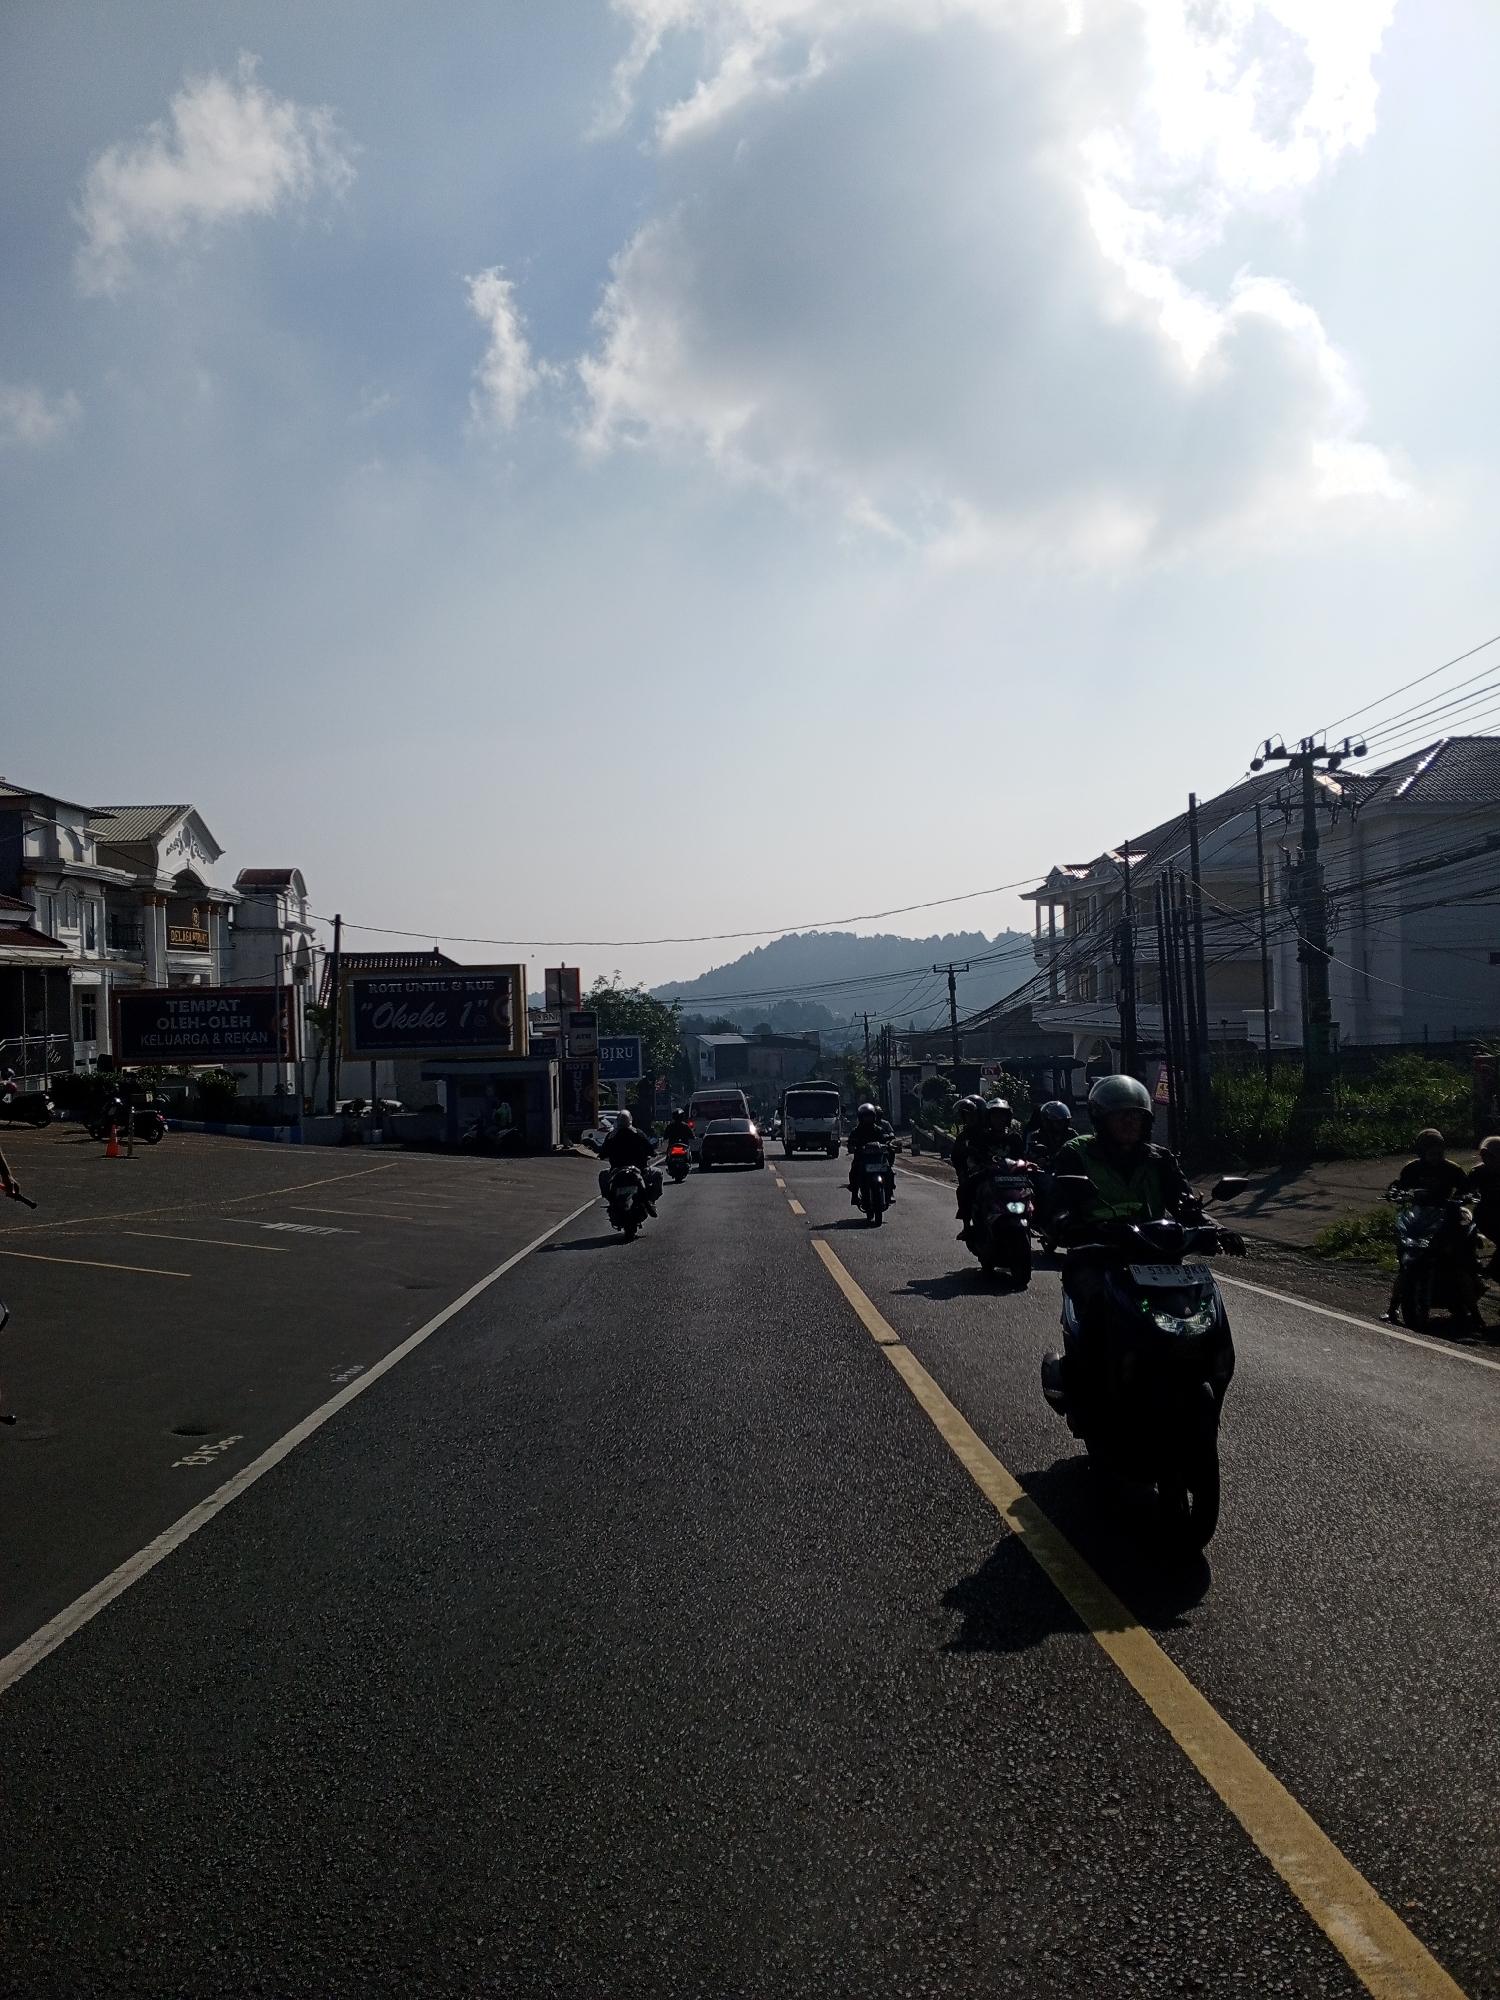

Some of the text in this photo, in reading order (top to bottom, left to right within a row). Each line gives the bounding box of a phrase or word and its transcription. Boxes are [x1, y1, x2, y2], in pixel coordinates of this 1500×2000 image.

[368, 980, 495, 993] ROTI UNYIL & KUE
[166, 999, 241, 1013] TEMPAT
[156, 1015, 251, 1030] OLEH-OLEH
[543, 1013, 558, 1021] BNI
[140, 1031, 268, 1046] KELUARGA & REKAN
[600, 1046, 634, 1059] BIRU
[1147, 1266, 1181, 1275] 5335
